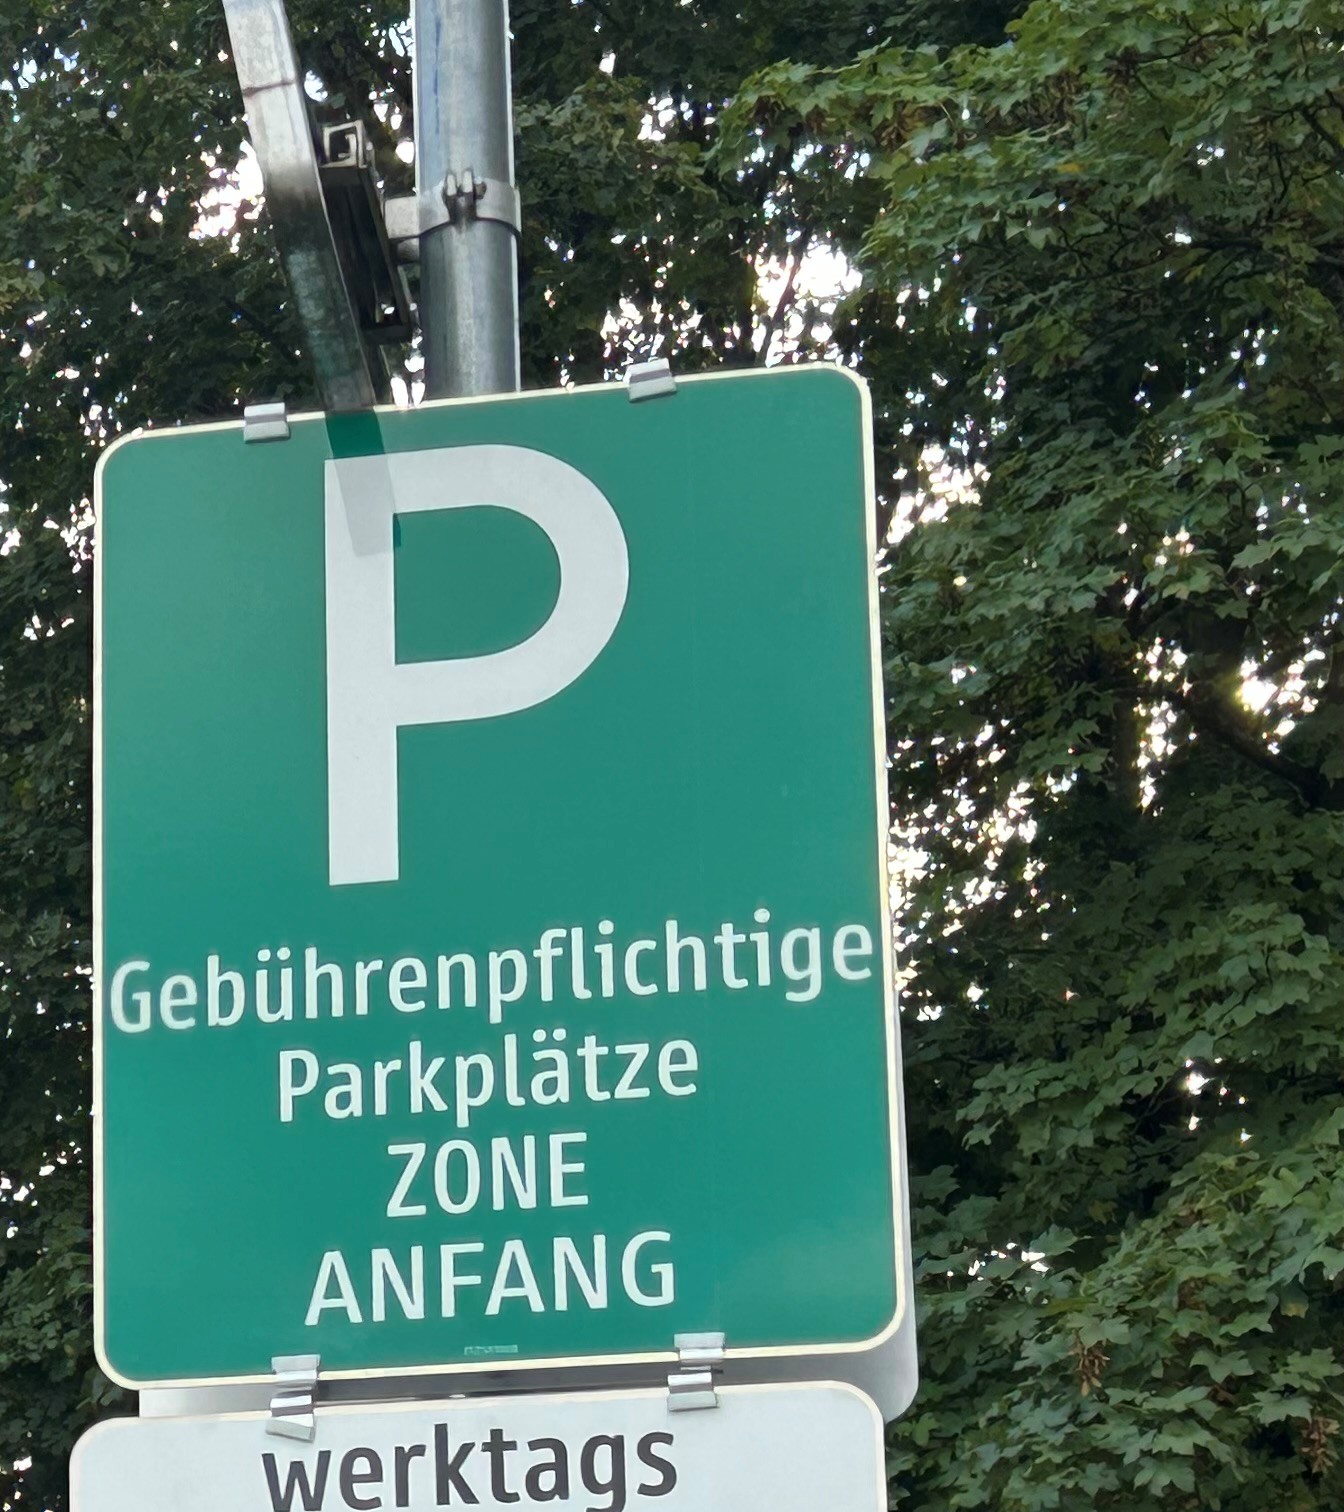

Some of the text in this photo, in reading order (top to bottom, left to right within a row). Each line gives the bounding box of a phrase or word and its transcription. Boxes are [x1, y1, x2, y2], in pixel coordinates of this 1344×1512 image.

[324, 443, 630, 886] P
[109, 907, 875, 1034] Gebührenpflichtige
[278, 1027, 700, 1128] Parkplätze
[385, 1130, 590, 1218] ZONE
[303, 1229, 676, 1327] ANFANG
